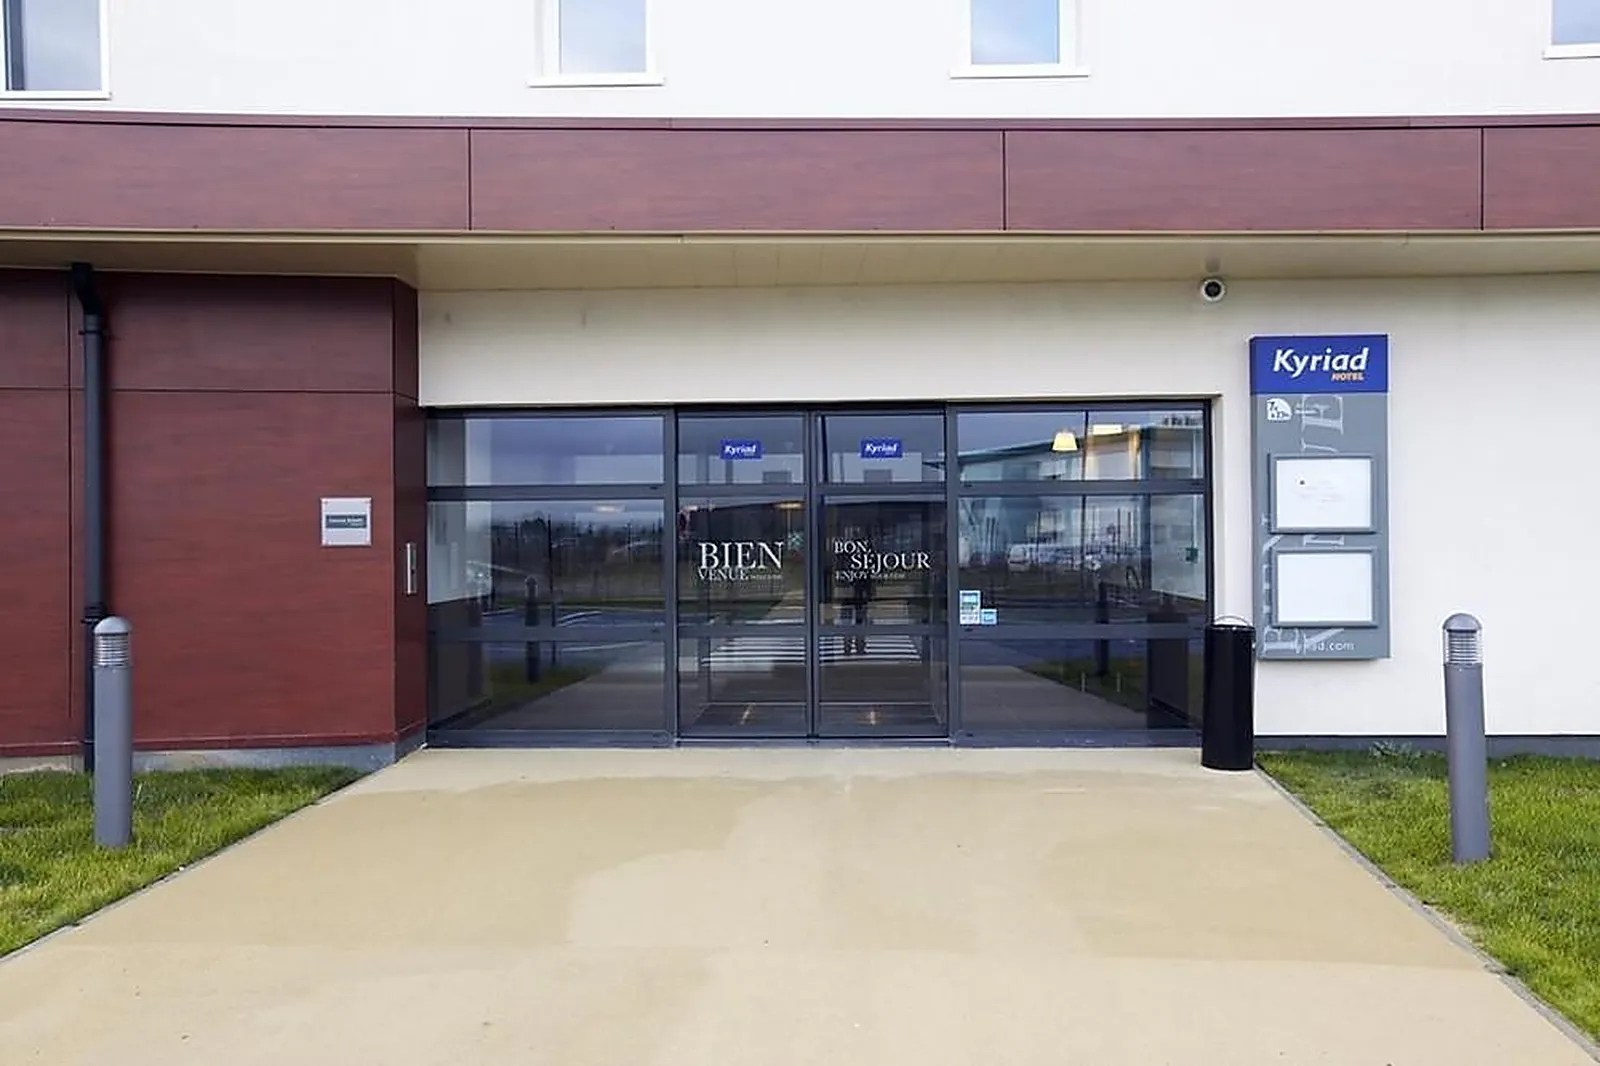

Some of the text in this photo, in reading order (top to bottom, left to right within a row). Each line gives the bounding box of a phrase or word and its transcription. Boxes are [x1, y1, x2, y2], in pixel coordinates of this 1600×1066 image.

[1273, 347, 1369, 378] Kyriad
[1332, 372, 1365, 381] HOTEL
[865, 443, 898, 455] Kyriad
[834, 541, 869, 553] BON
[698, 542, 784, 569] BIEN
[698, 567, 749, 580] VENUE
